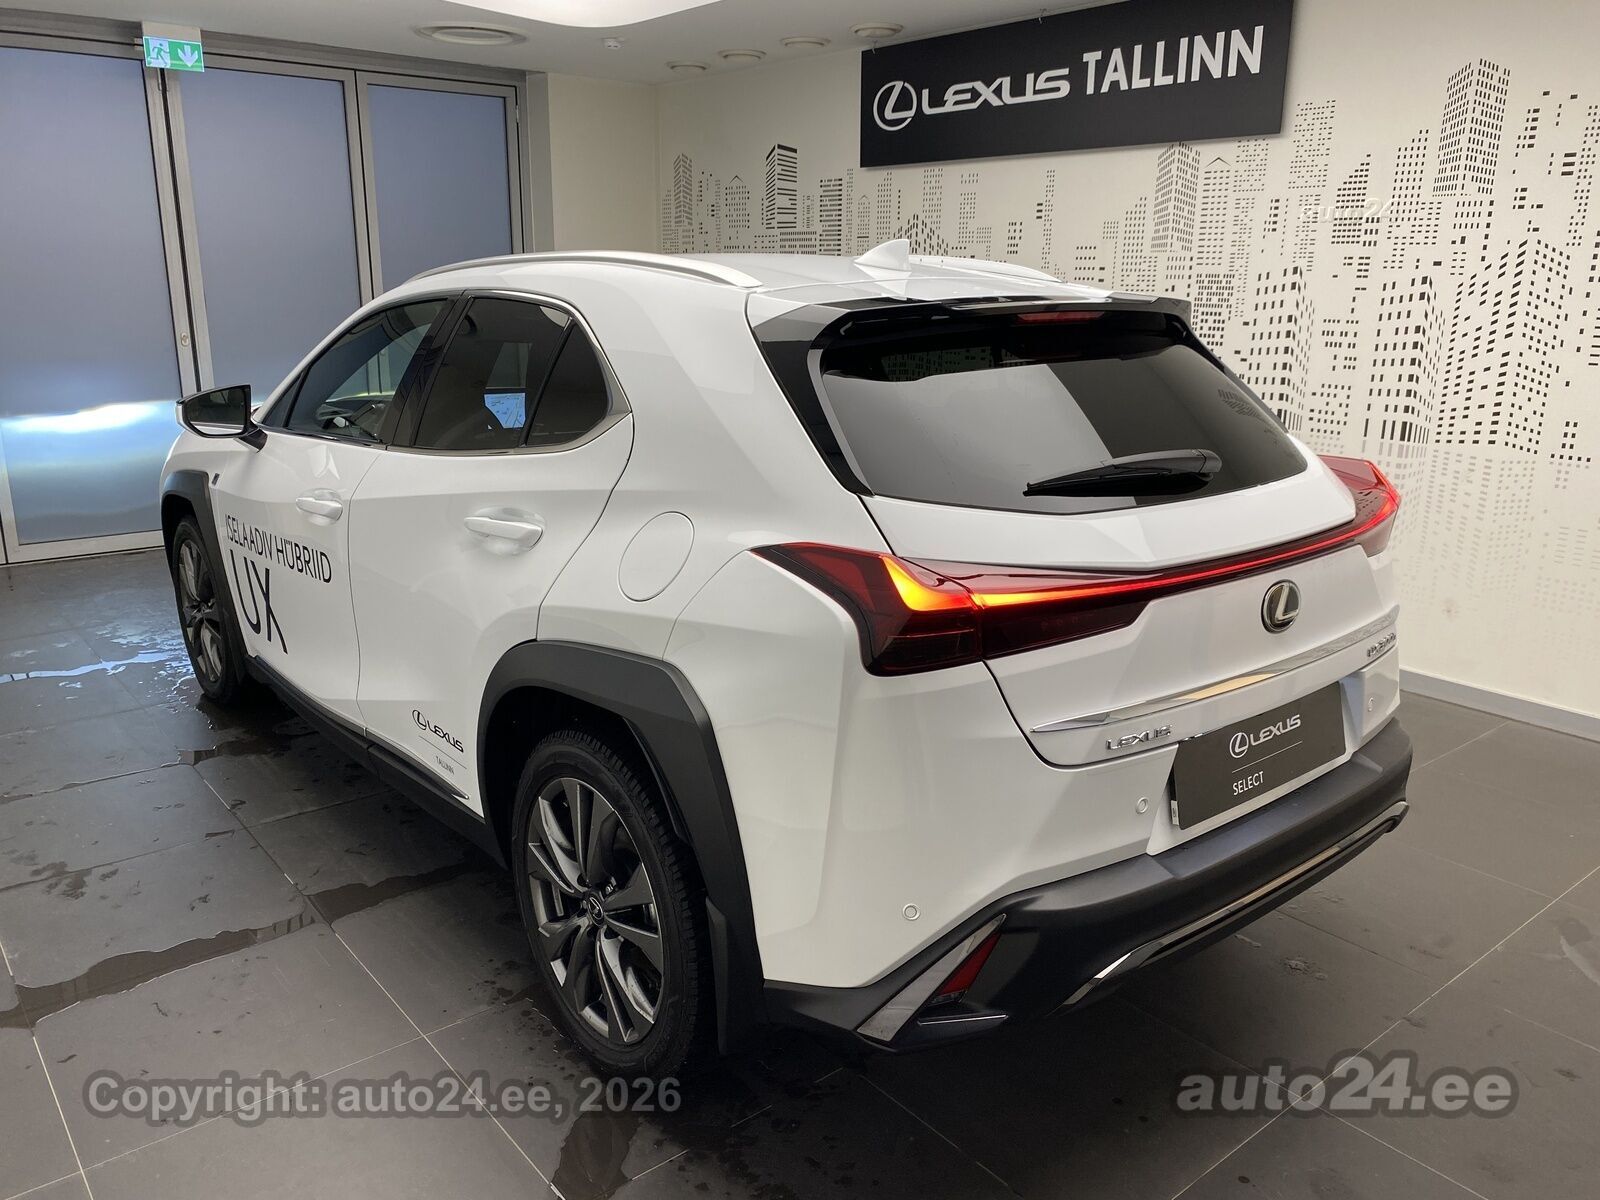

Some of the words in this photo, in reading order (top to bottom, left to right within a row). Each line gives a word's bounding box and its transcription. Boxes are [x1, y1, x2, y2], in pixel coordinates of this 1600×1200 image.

[921, 67, 1071, 116] LEXUS
[1082, 25, 1265, 96] TALLINN
[225, 514, 273, 561] ISELAADIV
[275, 535, 332, 584] HÜBRIID
[229, 549, 289, 655] UX
[426, 719, 464, 753] LEXUS
[1105, 724, 1173, 750] LEXUS
[1249, 714, 1301, 747] LEXUS
[1232, 771, 1265, 797] SELECT
